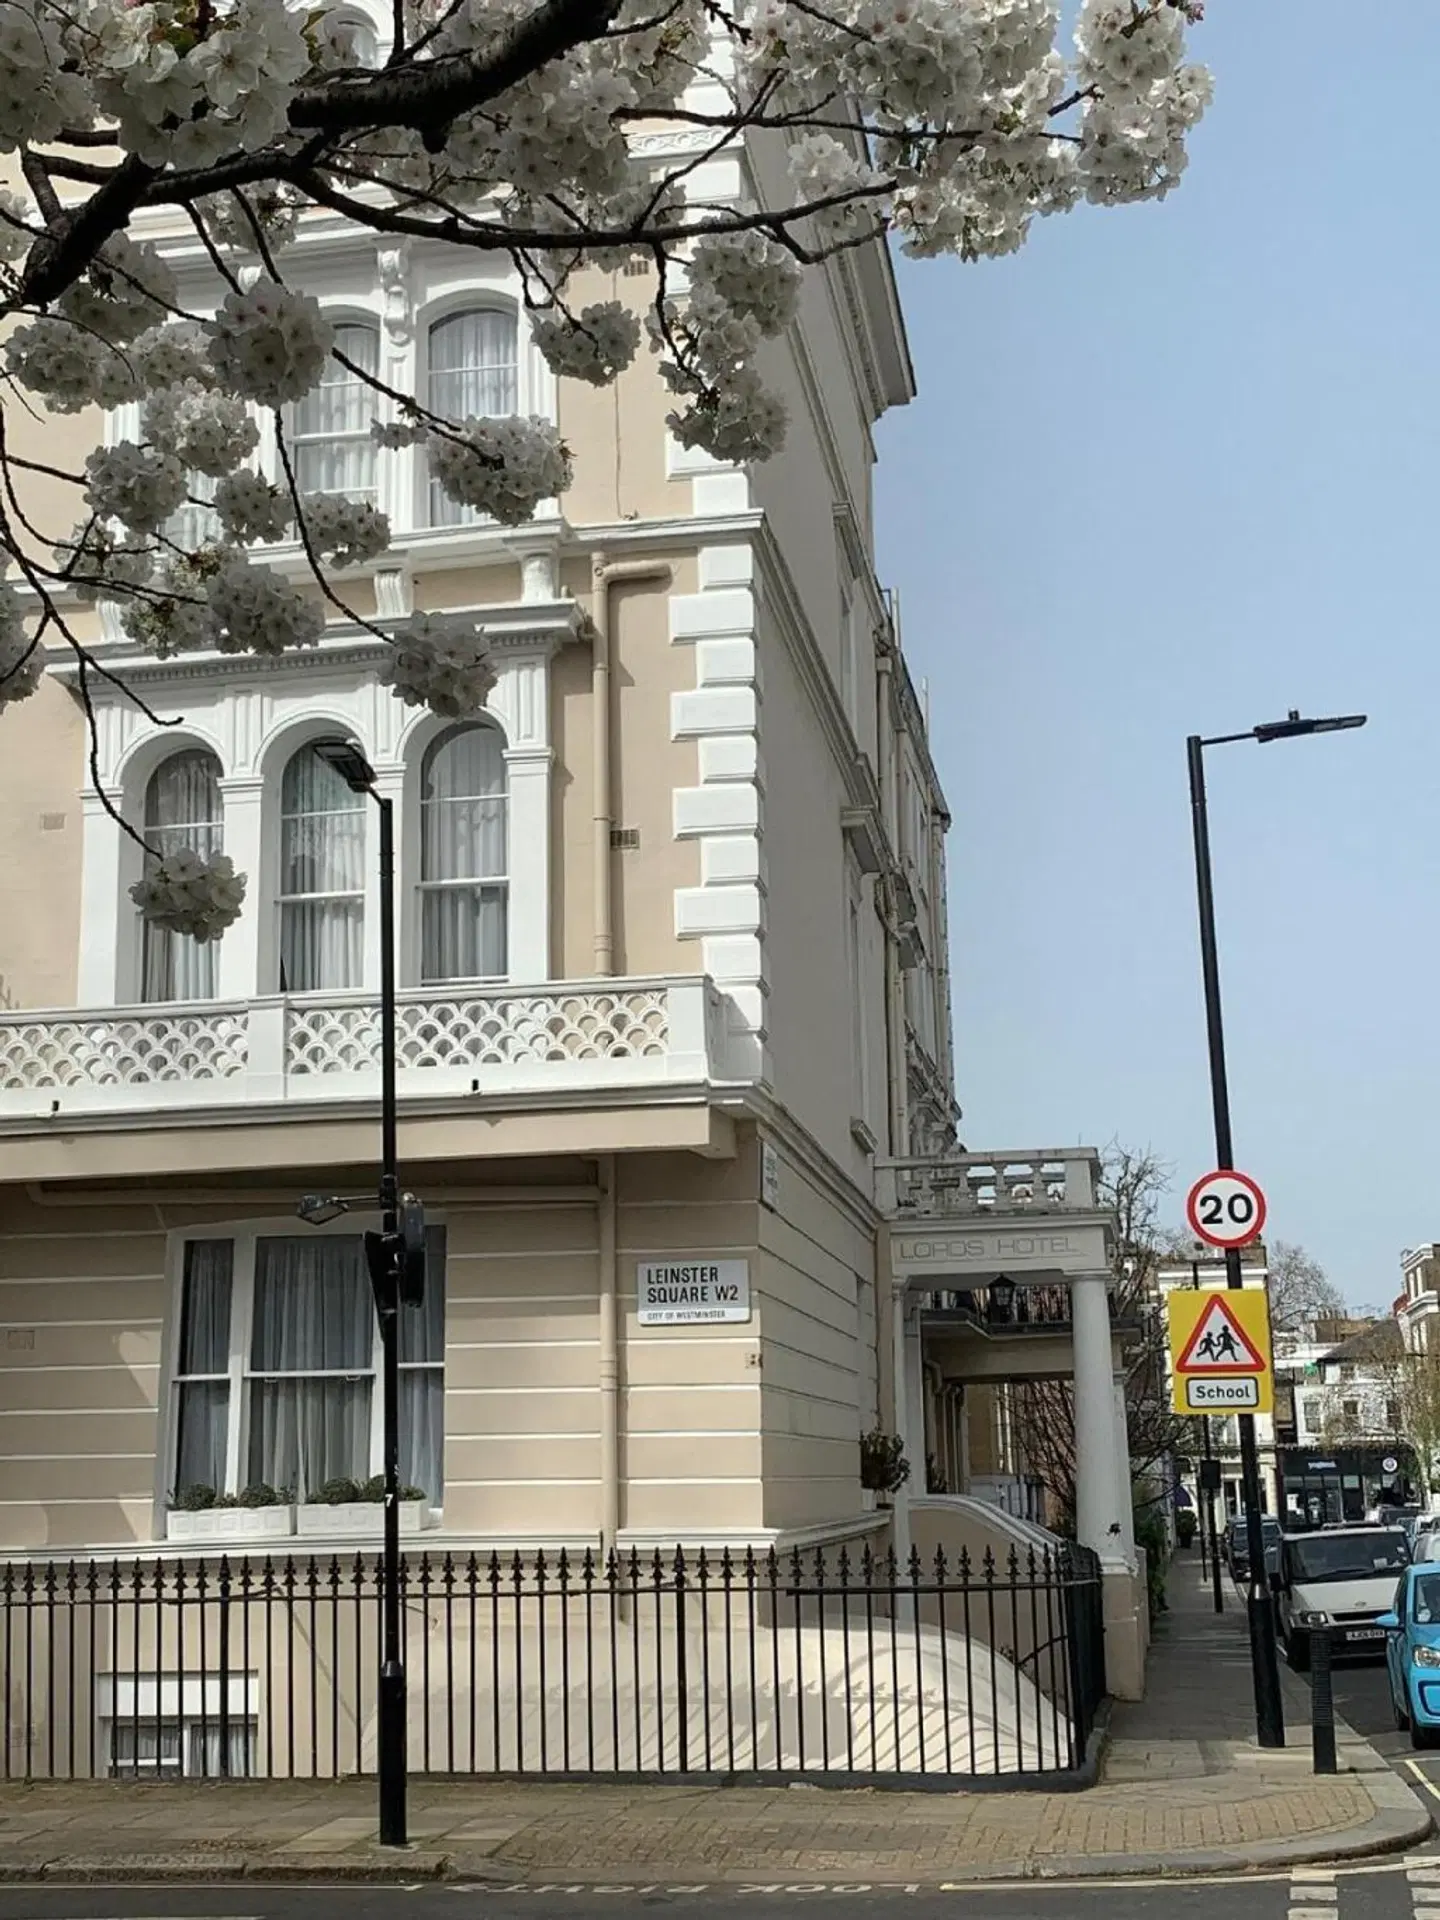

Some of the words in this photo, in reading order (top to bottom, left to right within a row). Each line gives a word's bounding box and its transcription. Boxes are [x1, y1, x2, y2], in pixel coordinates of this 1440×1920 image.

[1199, 1193, 1253, 1224] 20
[997, 1236, 1077, 1255] HOTEL
[647, 1266, 718, 1284] LEINSTER
[647, 1286, 709, 1303] SQUARE
[715, 1284, 738, 1301] W2
[1196, 1384, 1250, 1399] School
[385, 1493, 394, 1507] 7
[737, 1883, 921, 1893] LOOK
